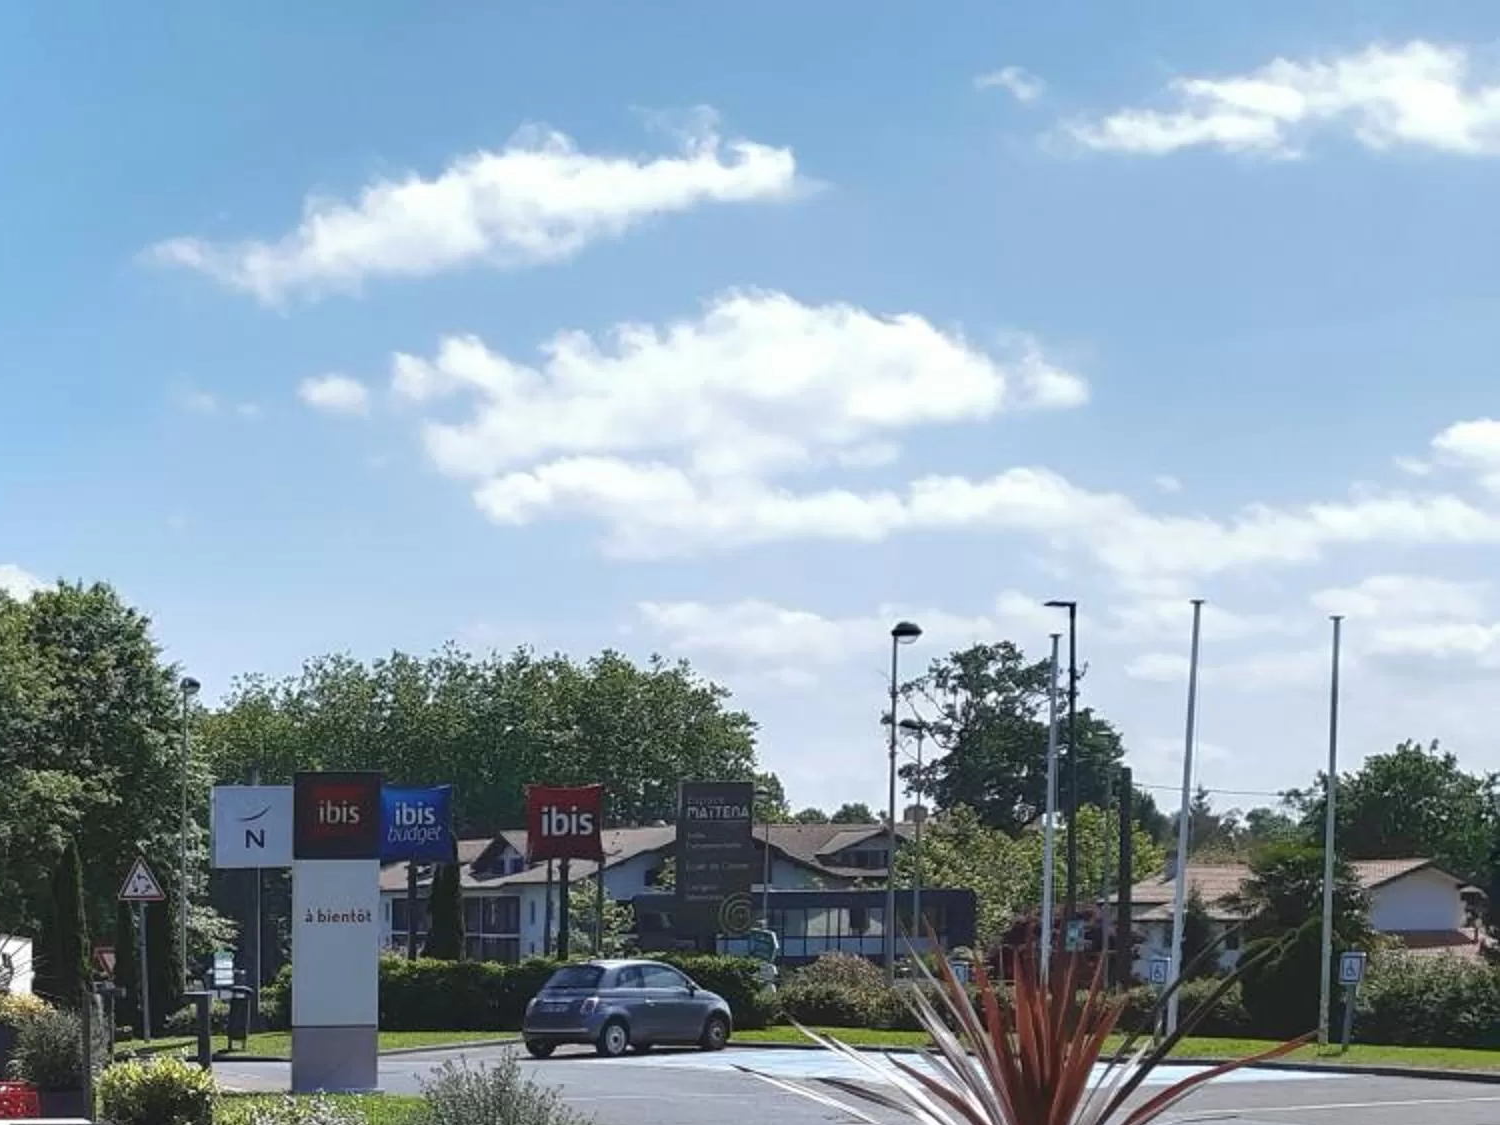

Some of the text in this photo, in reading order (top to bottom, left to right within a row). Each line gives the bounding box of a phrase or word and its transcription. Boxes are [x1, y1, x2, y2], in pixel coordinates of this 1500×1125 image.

[319, 799, 360, 825] ibis
[395, 801, 436, 825] ibis
[541, 805, 593, 837] ibis
[245, 828, 265, 849] N
[387, 824, 443, 846] budget
[304, 907, 373, 923] à bientôt
